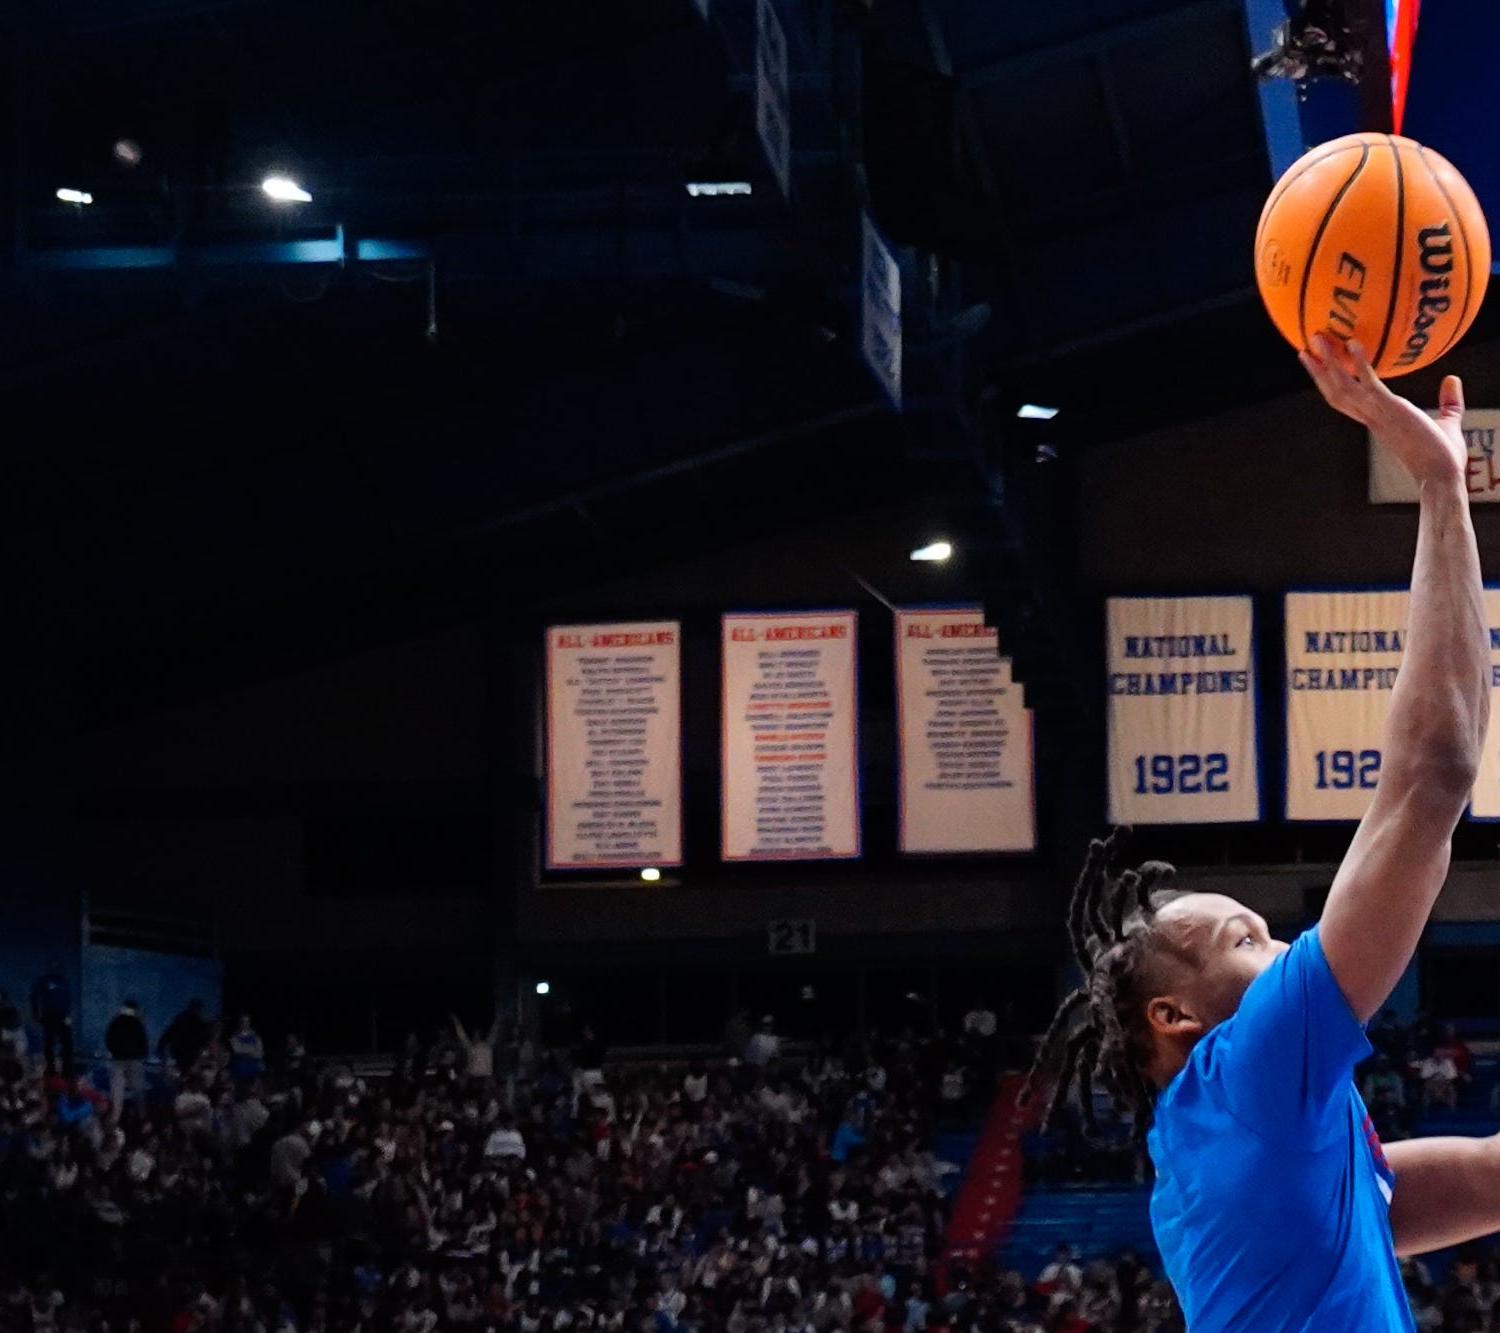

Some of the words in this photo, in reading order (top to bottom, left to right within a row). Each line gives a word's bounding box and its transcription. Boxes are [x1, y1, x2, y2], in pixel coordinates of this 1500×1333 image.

[1393, 219, 1453, 366] Wilson
[1124, 633, 1236, 659] NATIONAL
[1305, 630, 1408, 653] NATIONA
[1109, 670, 1249, 696] CHAMPIONS
[1292, 667, 1399, 690] CHAMPIO
[1135, 753, 1230, 795] 1922
[1315, 749, 1383, 789] 192
[771, 922, 811, 951] 21
